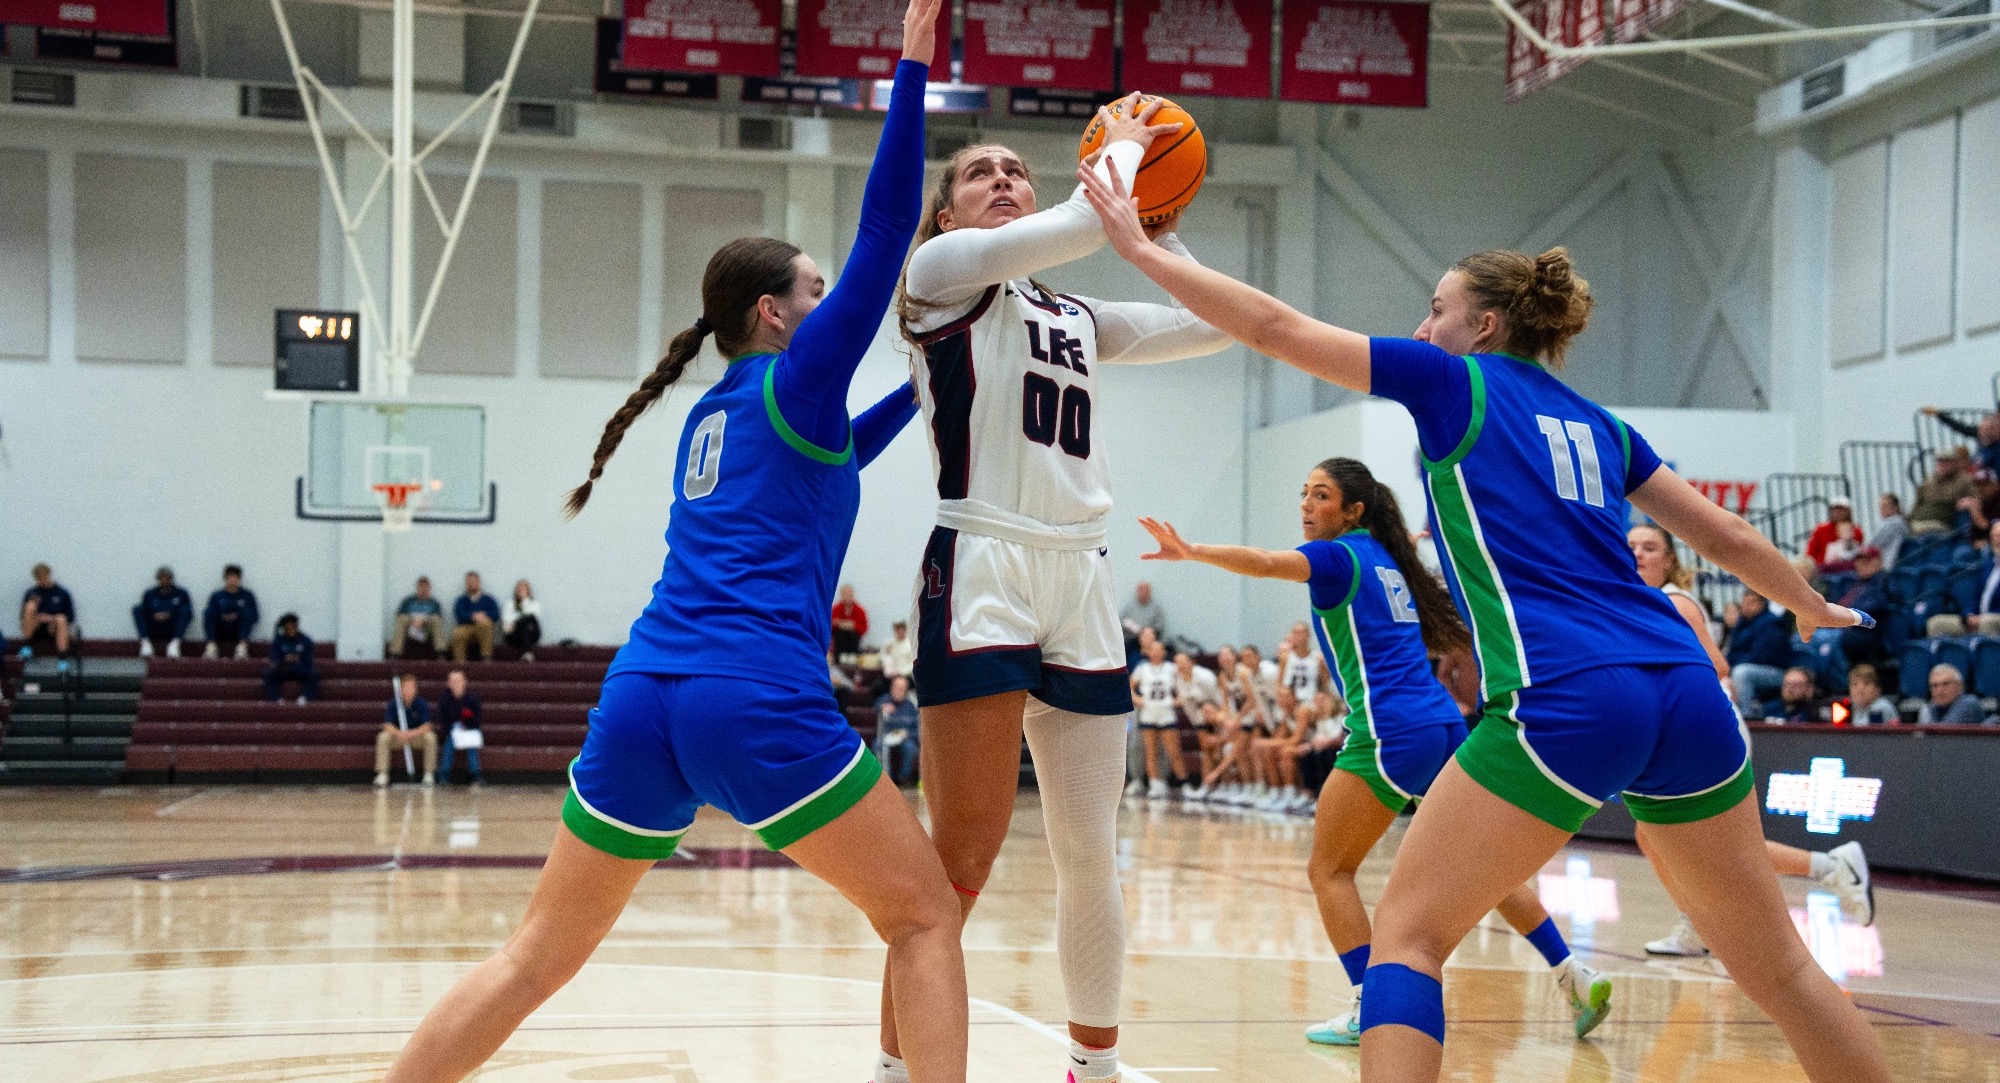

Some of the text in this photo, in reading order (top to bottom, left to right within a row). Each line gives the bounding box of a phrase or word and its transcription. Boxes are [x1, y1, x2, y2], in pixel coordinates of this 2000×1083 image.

[1024, 319, 1088, 377] LEE
[1023, 370, 1091, 460] 00
[683, 409, 727, 500] 0
[1535, 414, 1604, 508] 11
[1687, 480, 1756, 514] ITY
[1374, 565, 1419, 623] 12
